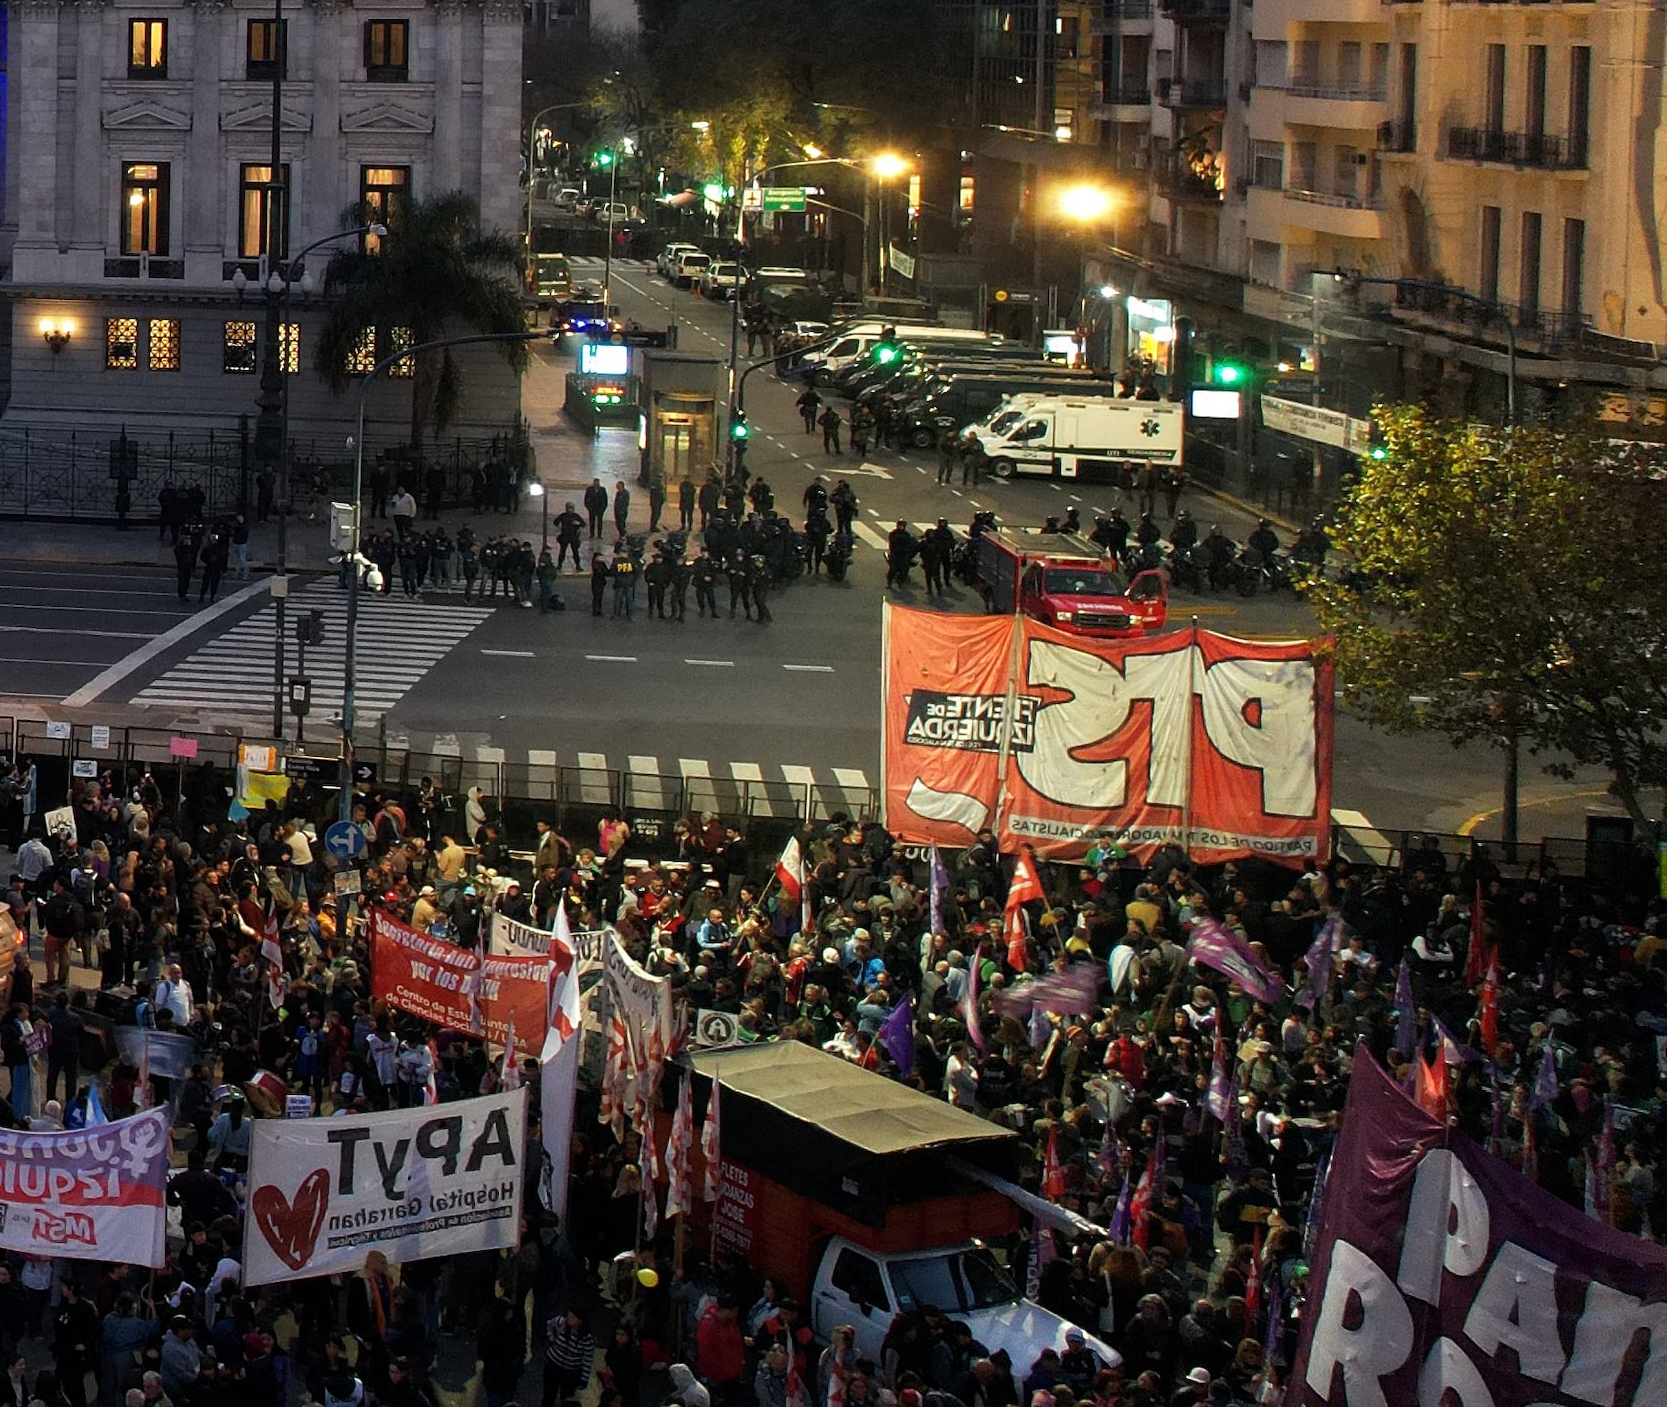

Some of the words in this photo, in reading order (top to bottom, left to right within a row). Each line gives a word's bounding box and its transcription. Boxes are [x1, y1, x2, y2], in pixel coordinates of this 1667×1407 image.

[617, 562, 634, 573] PFA
[435, 966, 459, 991] los
[386, 992, 400, 1004] de
[401, 998, 445, 1023] Ciencias
[396, 985, 431, 1008] Centro
[432, 1000, 446, 1013] de
[721, 1200, 746, 1225] JOSE
